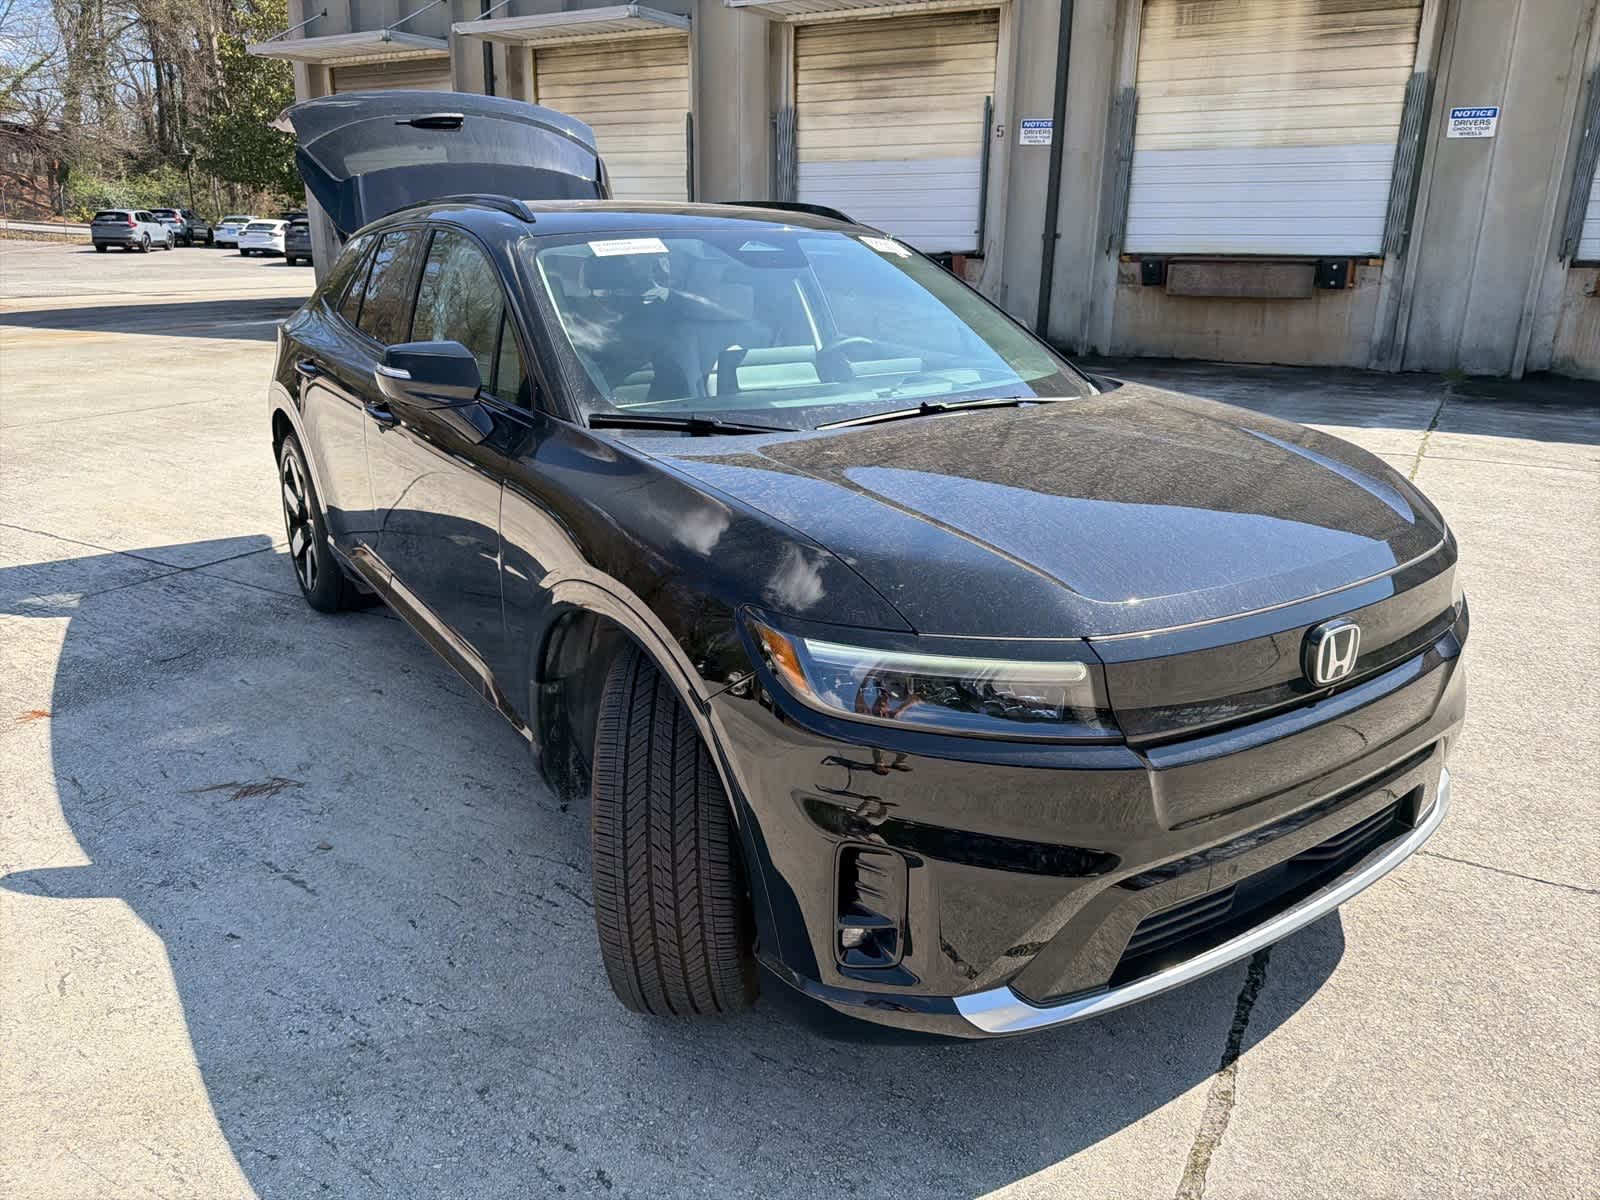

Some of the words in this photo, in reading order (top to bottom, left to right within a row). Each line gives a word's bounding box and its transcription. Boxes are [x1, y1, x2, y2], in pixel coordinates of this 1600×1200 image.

[1453, 109, 1495, 118] NOTICE
[1023, 120, 1053, 128] NOTICE
[1453, 119, 1491, 127] DRIVERS
[996, 124, 1005, 138] 5
